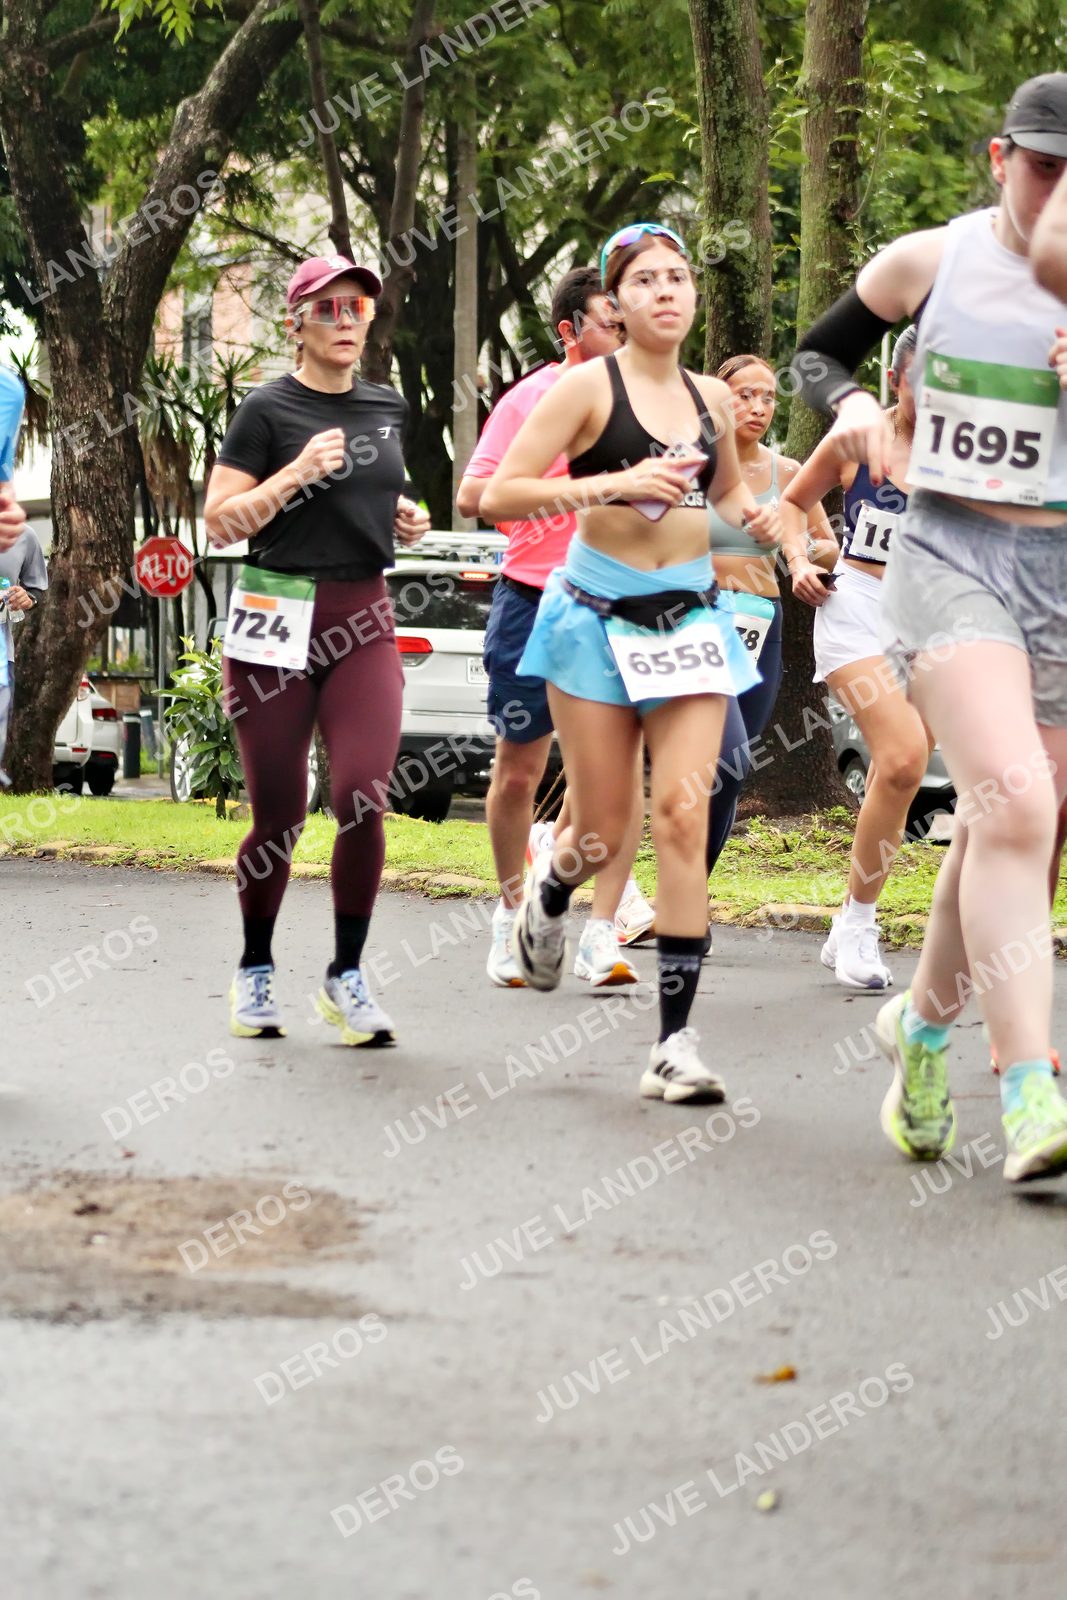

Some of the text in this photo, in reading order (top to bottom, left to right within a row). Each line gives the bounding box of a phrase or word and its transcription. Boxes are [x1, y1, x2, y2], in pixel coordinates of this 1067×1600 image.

[930, 415, 1041, 469] 1695
[140, 555, 189, 579] ALTO
[231, 608, 291, 643] 724
[628, 641, 724, 676] 6558
